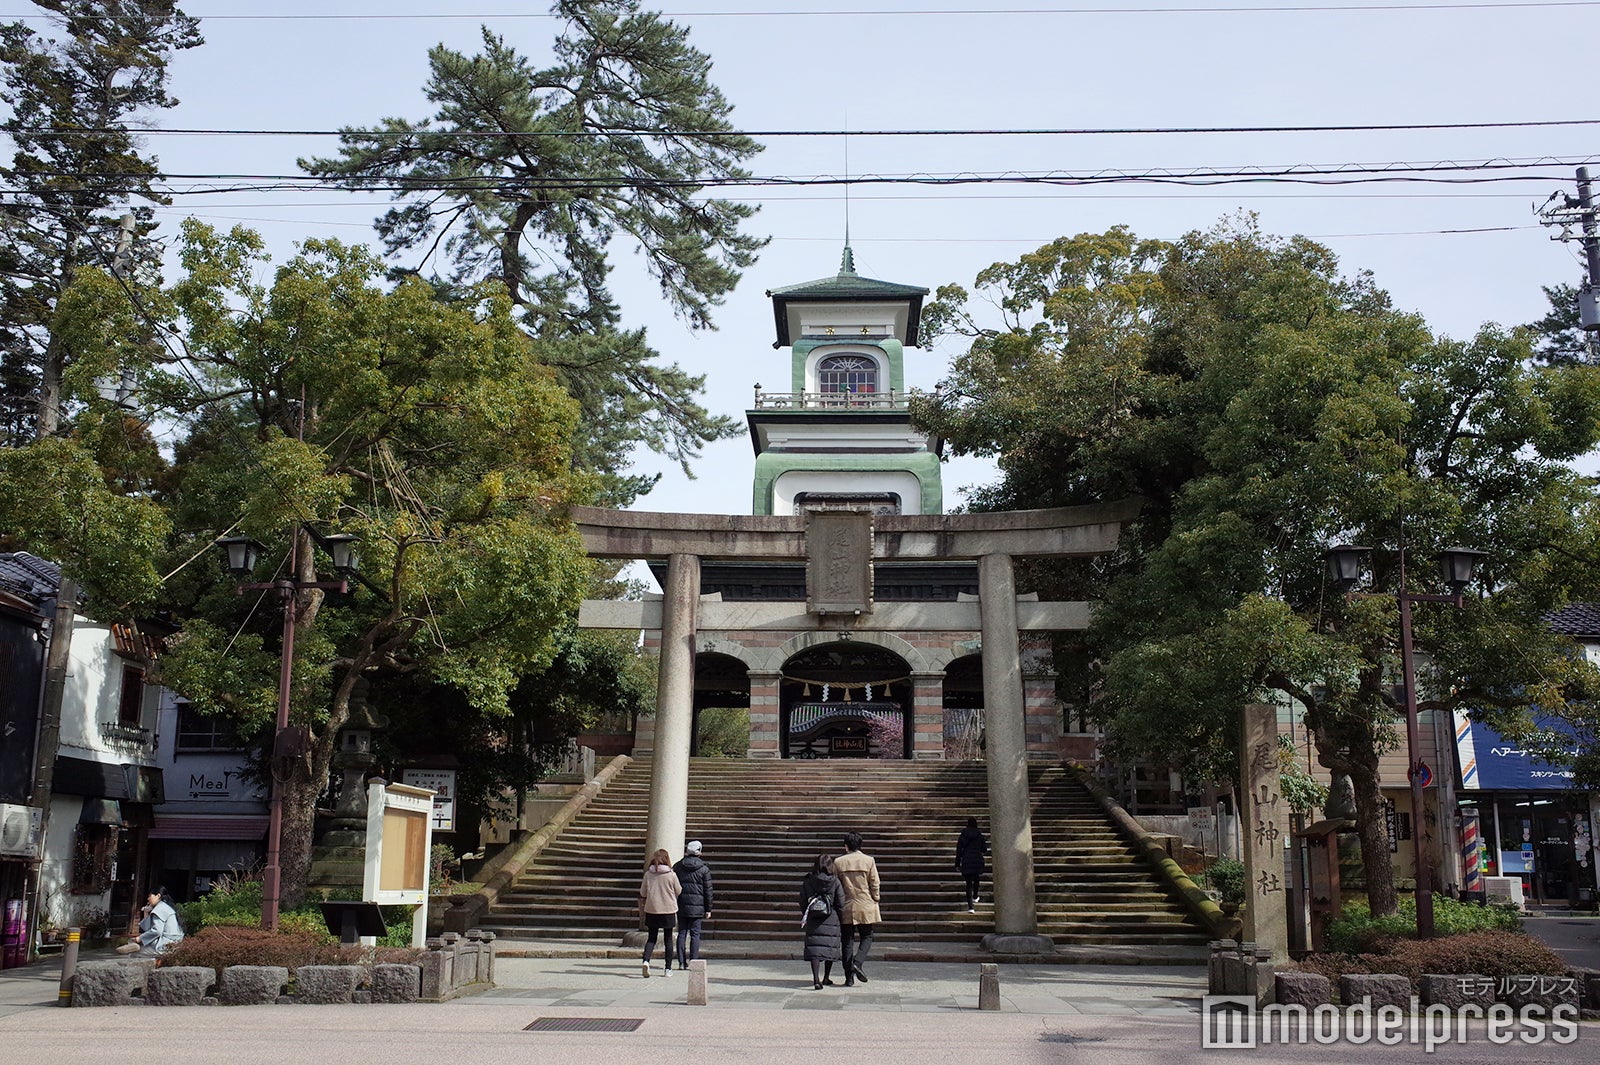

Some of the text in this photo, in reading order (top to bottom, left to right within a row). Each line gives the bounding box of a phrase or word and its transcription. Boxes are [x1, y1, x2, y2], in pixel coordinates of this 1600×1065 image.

[190, 767, 230, 789] Meal
[1250, 743, 1283, 896] 尾山神社
